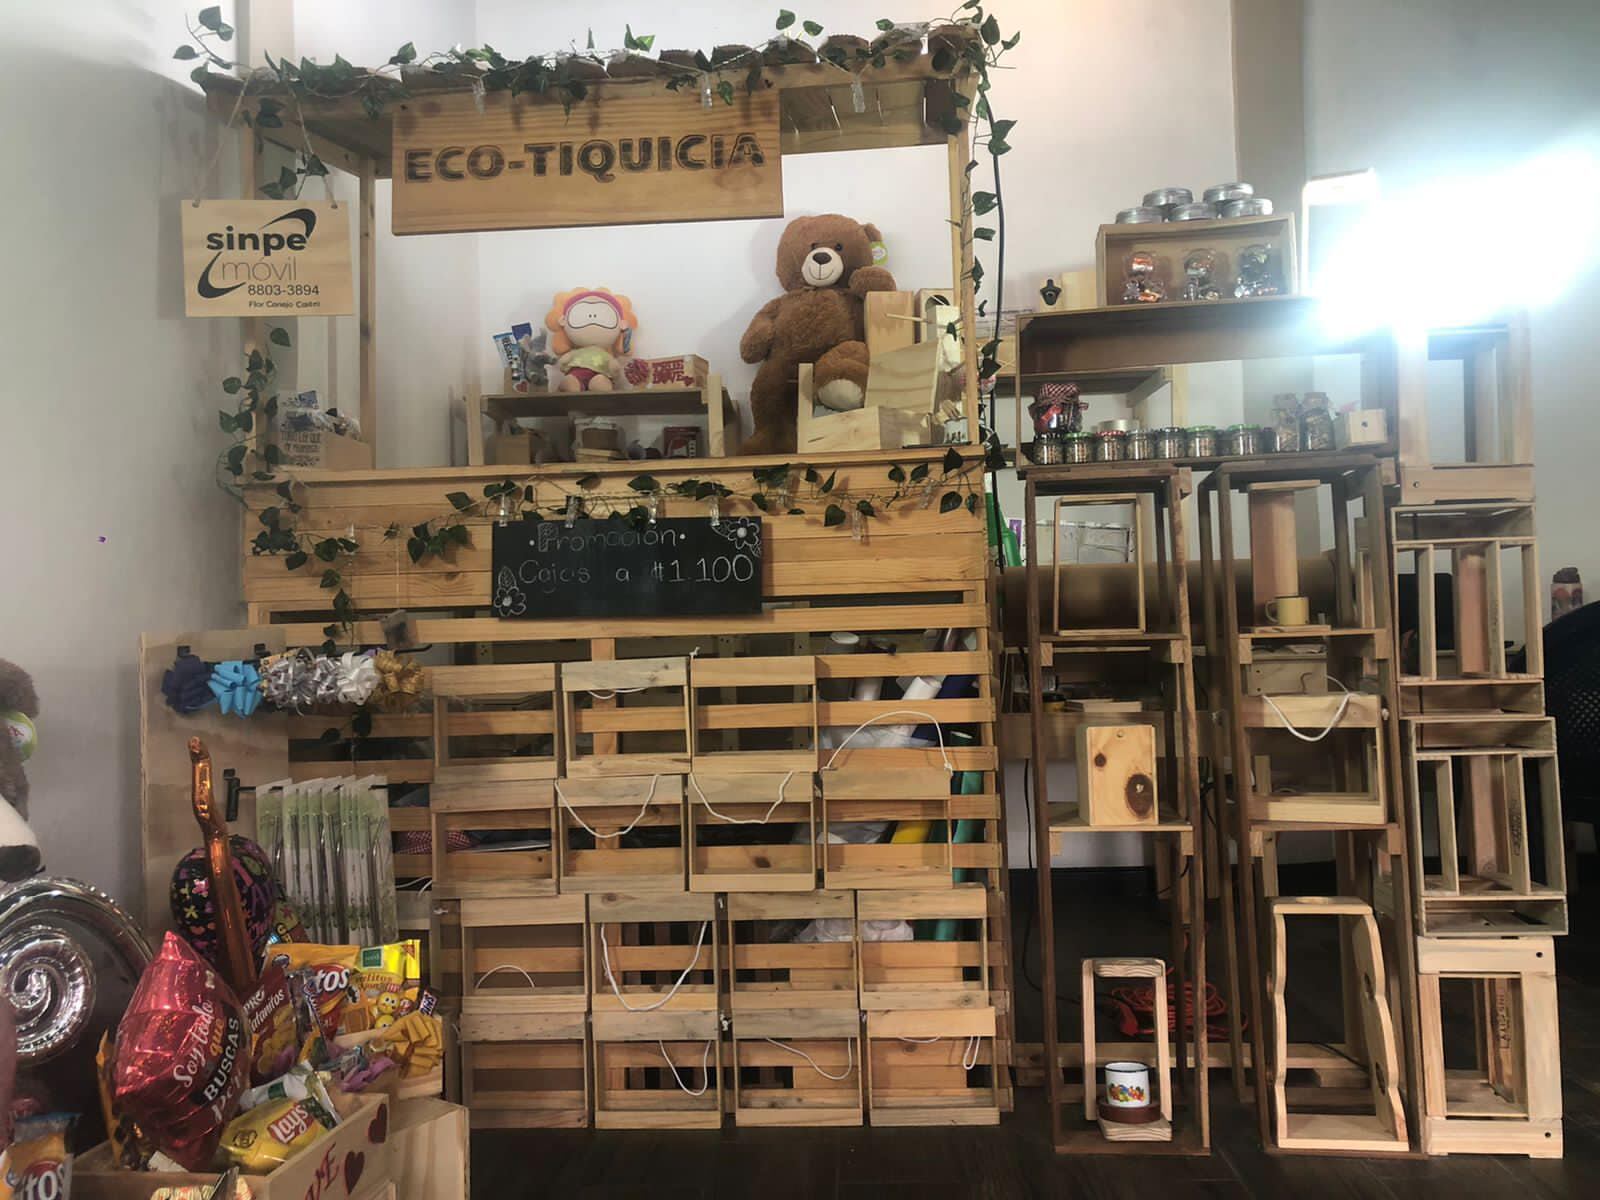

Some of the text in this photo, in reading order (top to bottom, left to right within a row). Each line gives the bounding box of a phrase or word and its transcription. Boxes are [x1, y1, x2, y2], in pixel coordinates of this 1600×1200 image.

[404, 131, 765, 184] ECO-TIQUICIA
[206, 225, 307, 256] sinpe
[221, 256, 297, 281] móvil
[247, 284, 320, 296] 8803-3894
[615, 567, 630, 582] a
[173, 1000, 215, 1088] Soy todo
[210, 1018, 225, 1057] que
[203, 1017, 239, 1101] BUSCAS
